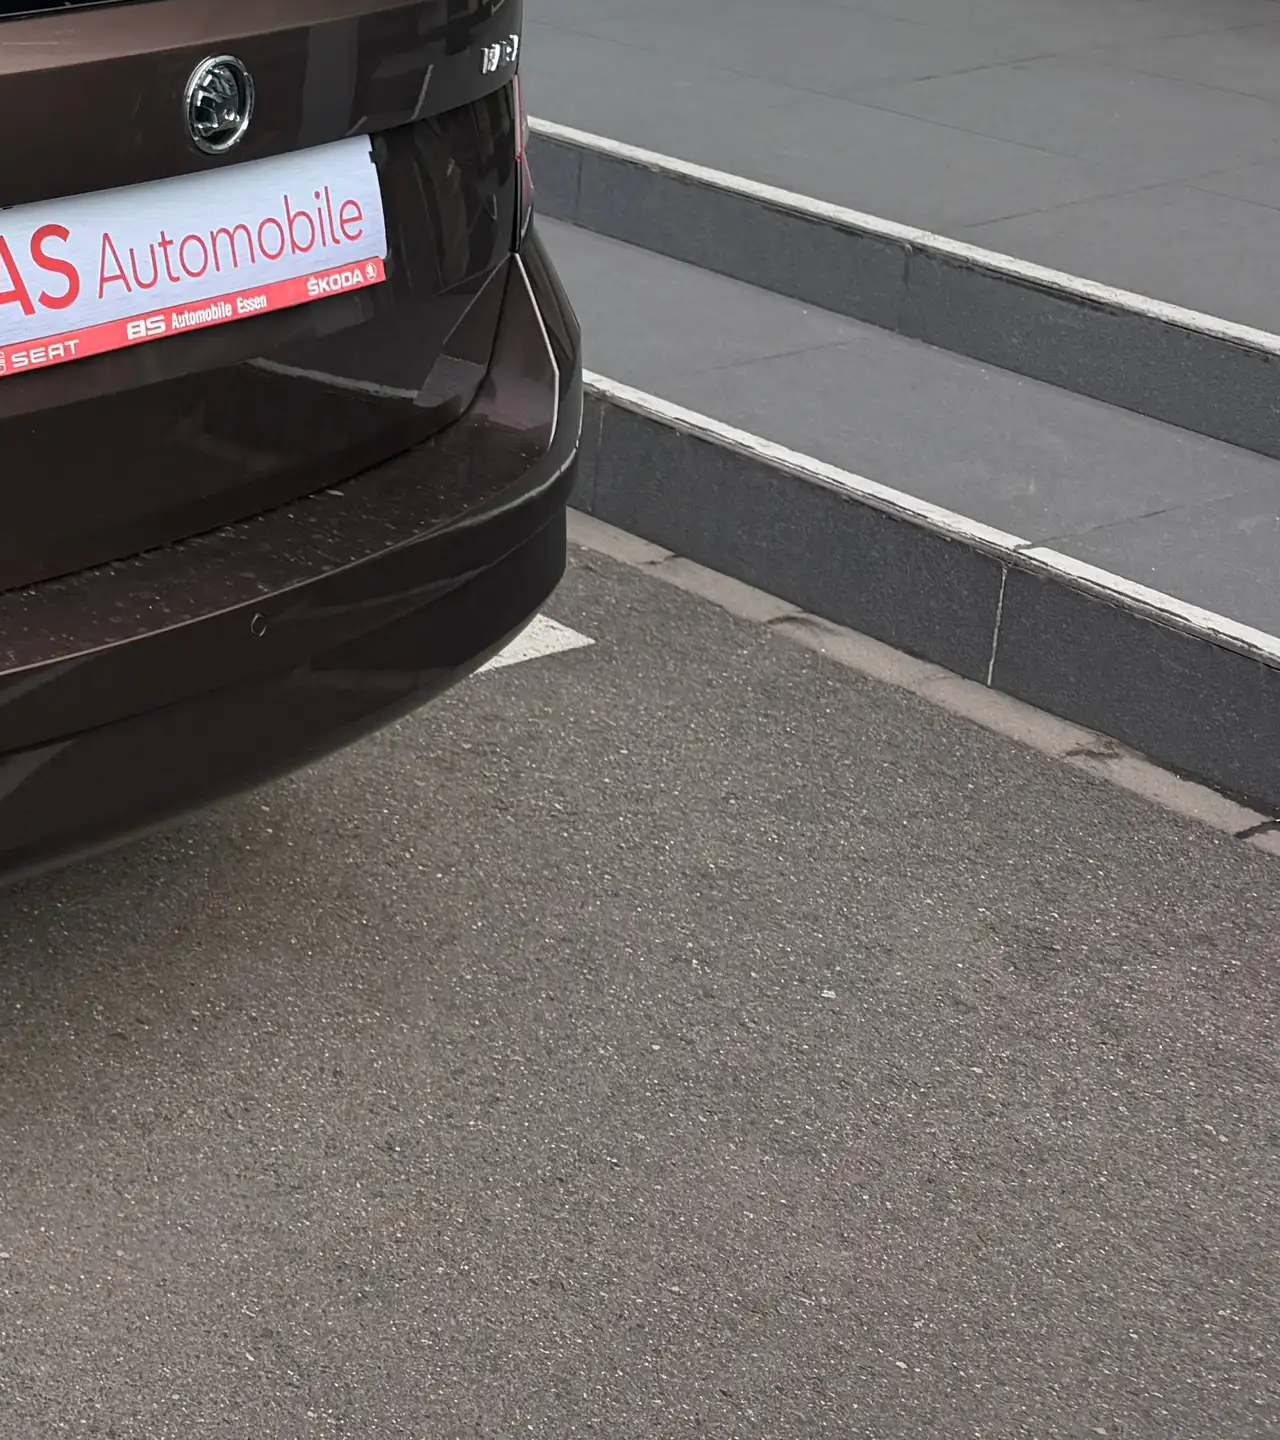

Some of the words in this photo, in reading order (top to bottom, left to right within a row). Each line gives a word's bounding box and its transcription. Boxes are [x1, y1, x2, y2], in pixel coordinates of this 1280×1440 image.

[98, 186, 365, 300] Automobile
[11, 339, 80, 369] SEAT
[126, 315, 167, 340] AS
[171, 301, 233, 329] Automobile
[236, 294, 268, 314] Essen
[306, 270, 365, 297] ŠKODA
